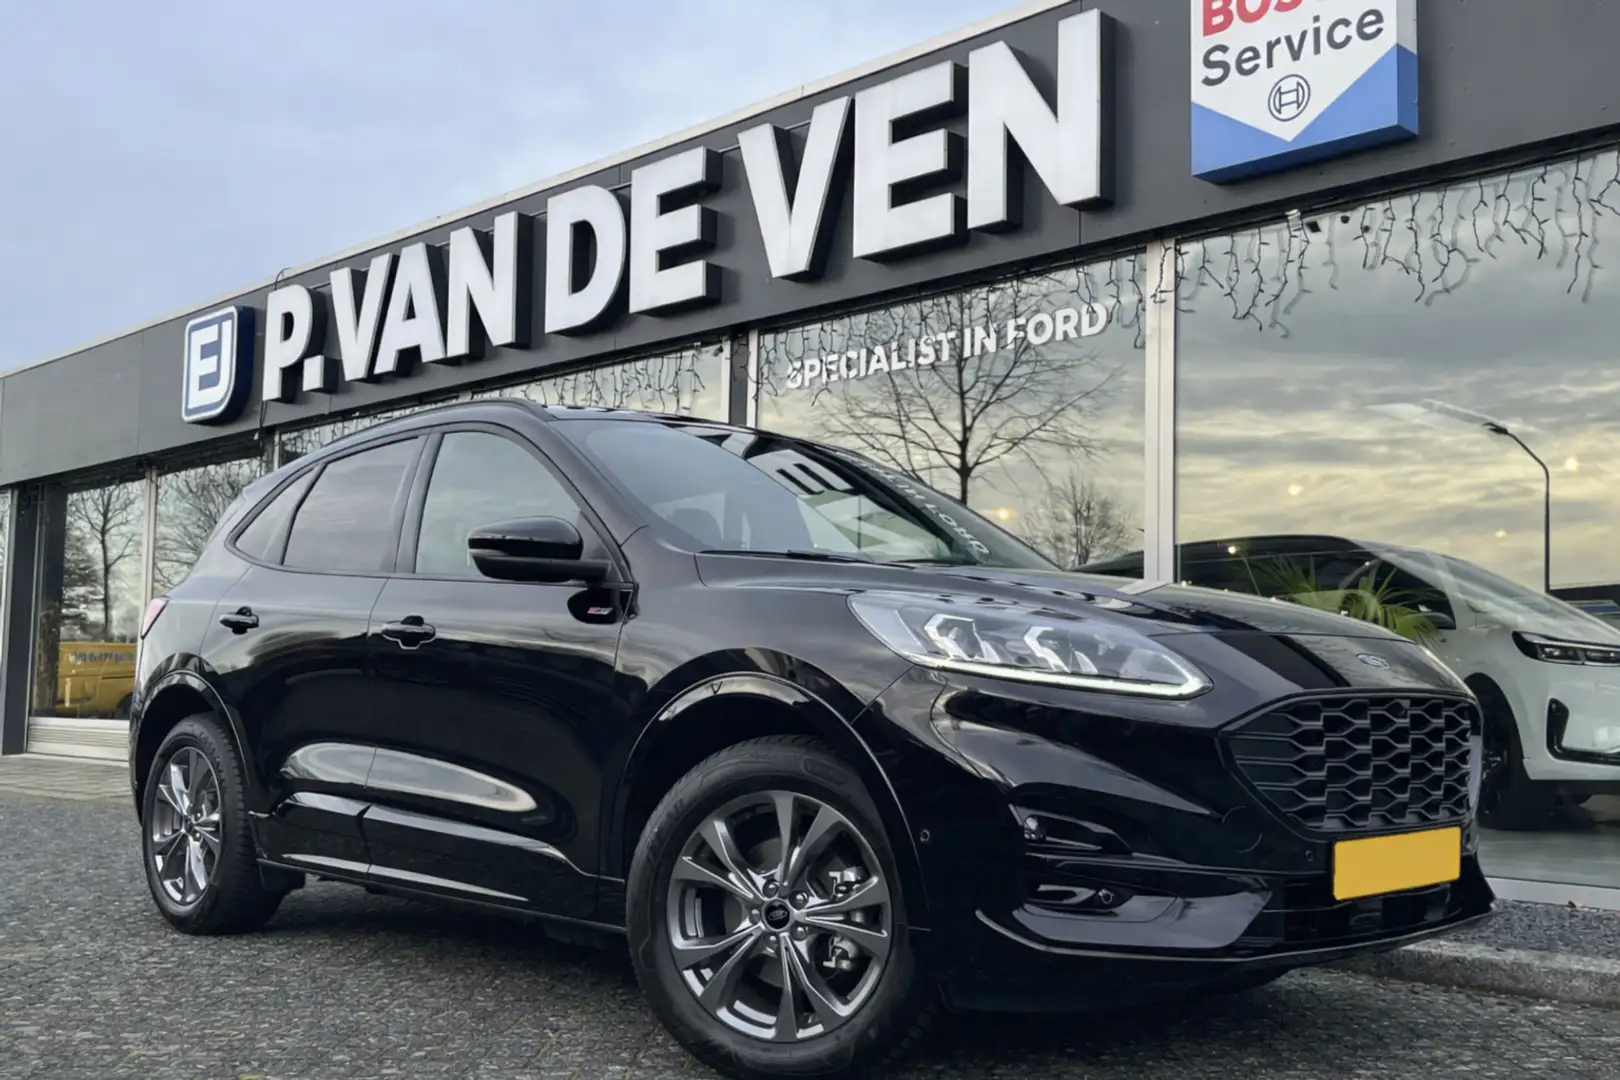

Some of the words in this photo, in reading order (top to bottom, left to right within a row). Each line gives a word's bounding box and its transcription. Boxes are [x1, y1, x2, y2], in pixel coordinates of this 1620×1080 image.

[1201, 8, 1384, 87] Service
[1203, 0, 1318, 37] BO
[544, 146, 707, 335] DE
[737, 8, 1103, 279] VEN
[785, 331, 958, 389] SPECIALIST
[963, 323, 997, 358] IN
[1005, 302, 1109, 350] FORD
